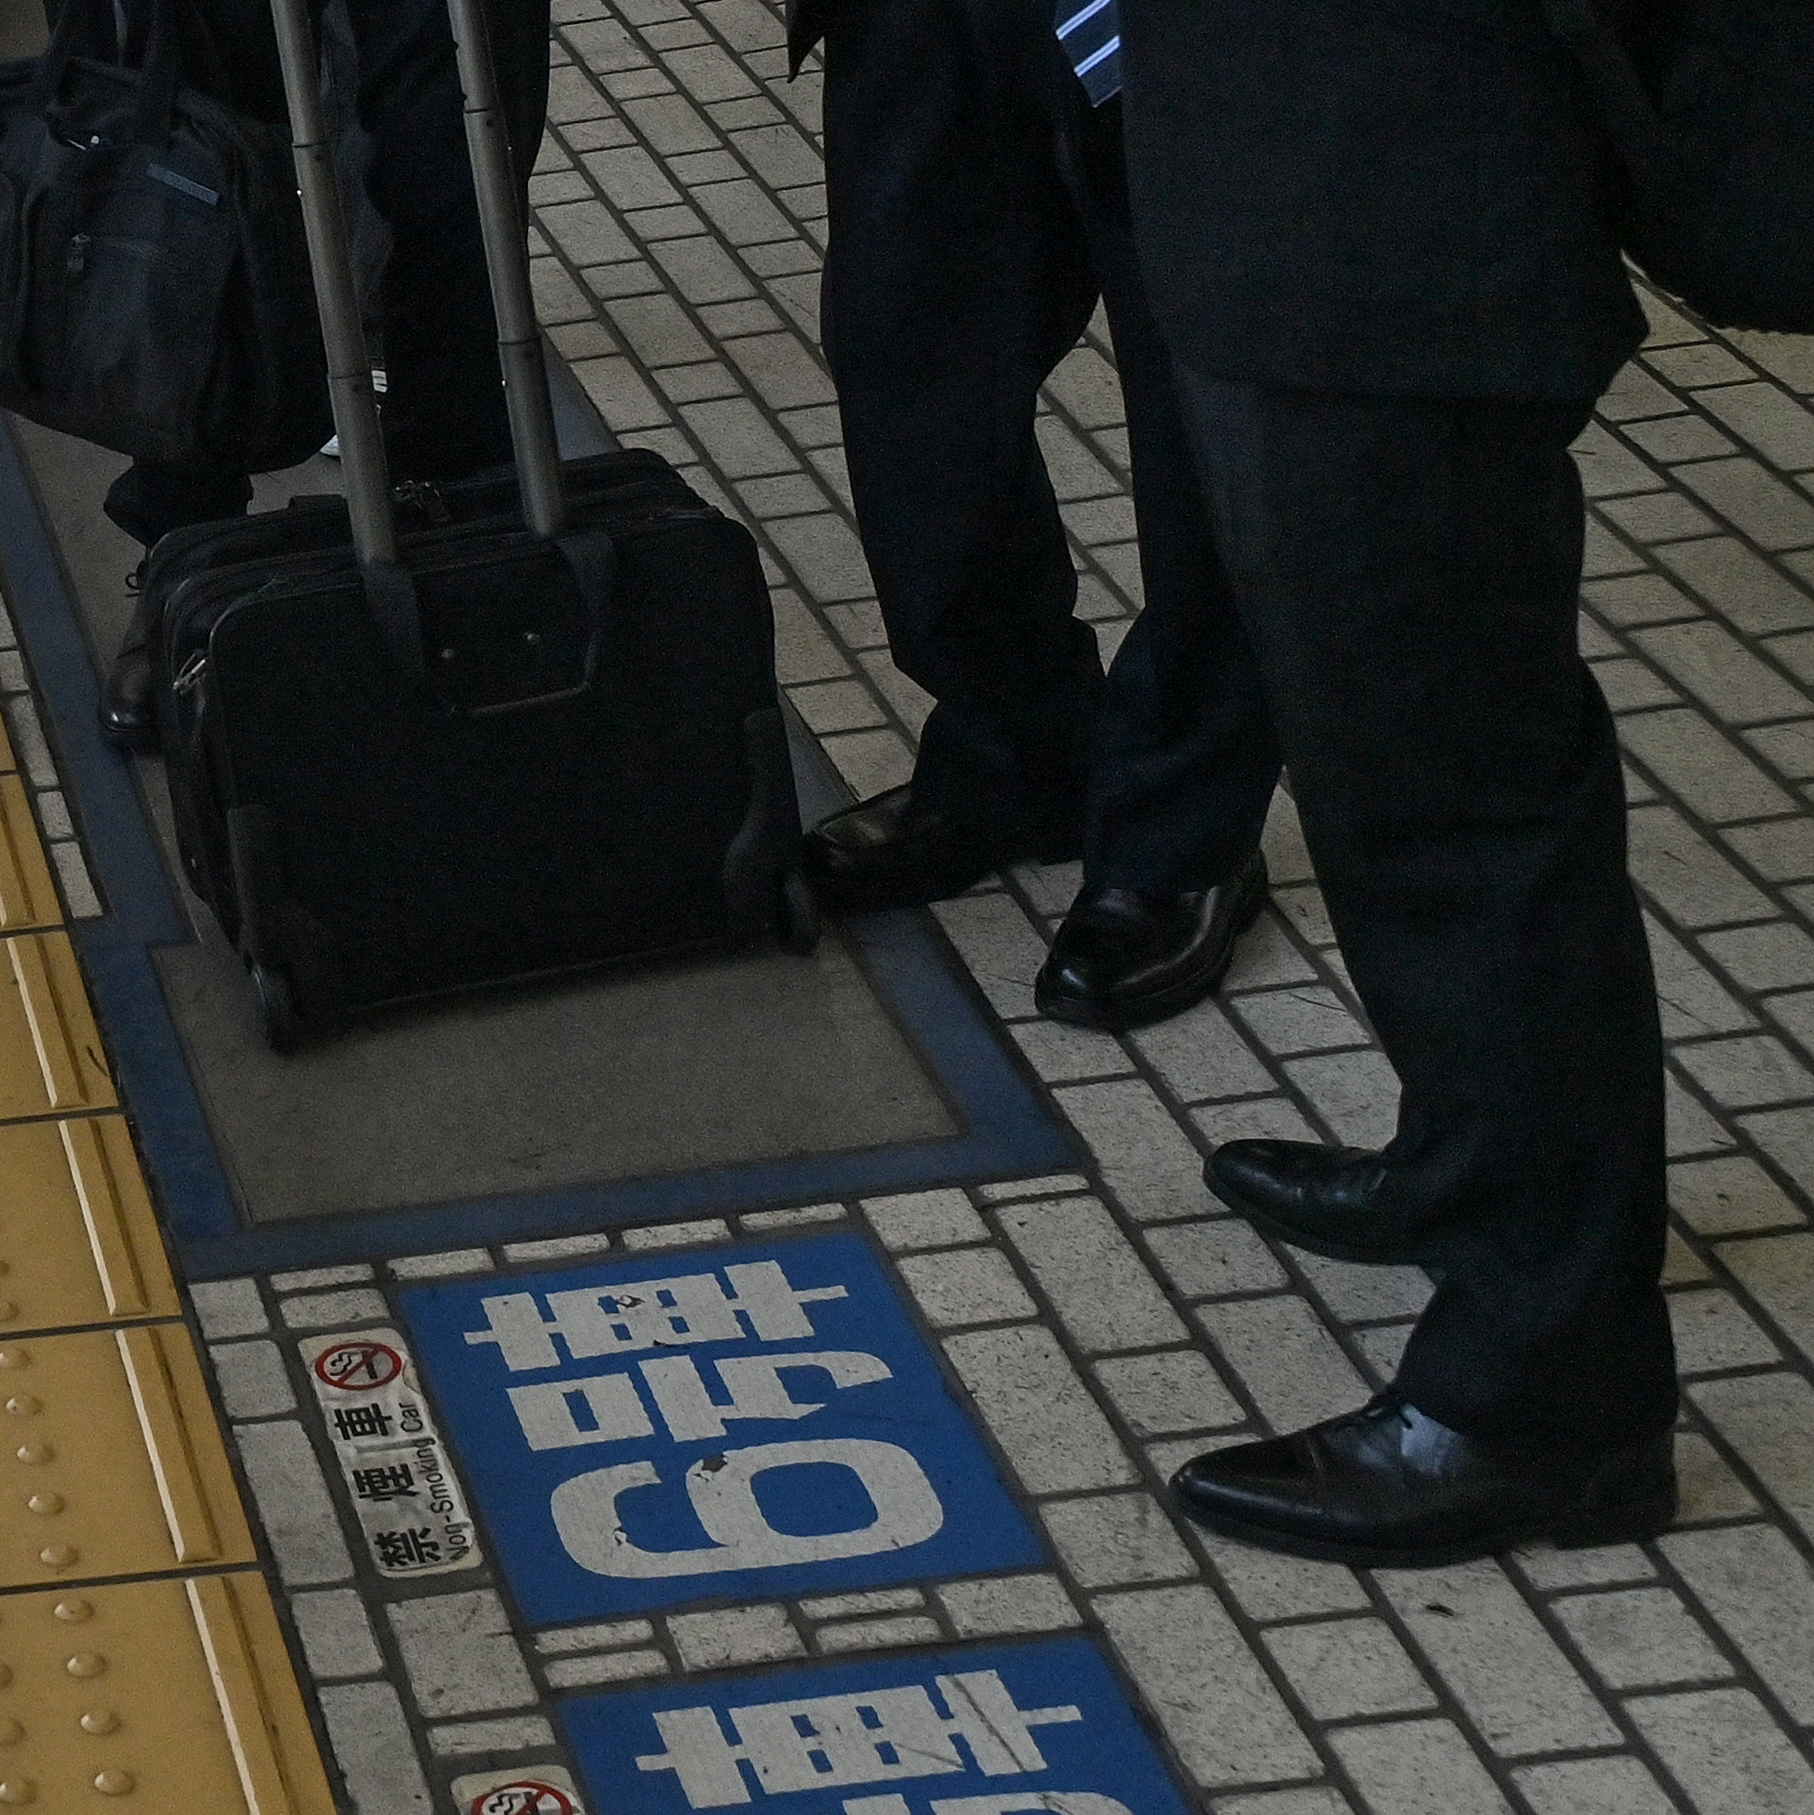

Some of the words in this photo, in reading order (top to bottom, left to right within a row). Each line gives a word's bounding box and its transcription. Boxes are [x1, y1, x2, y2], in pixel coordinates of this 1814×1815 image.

[333, 1402, 442, 1568] 禁煙車
[398, 1401, 424, 1435] Car
[463, 1259, 945, 1580] 6号車
[412, 1436, 472, 1562] Non-Smoking
